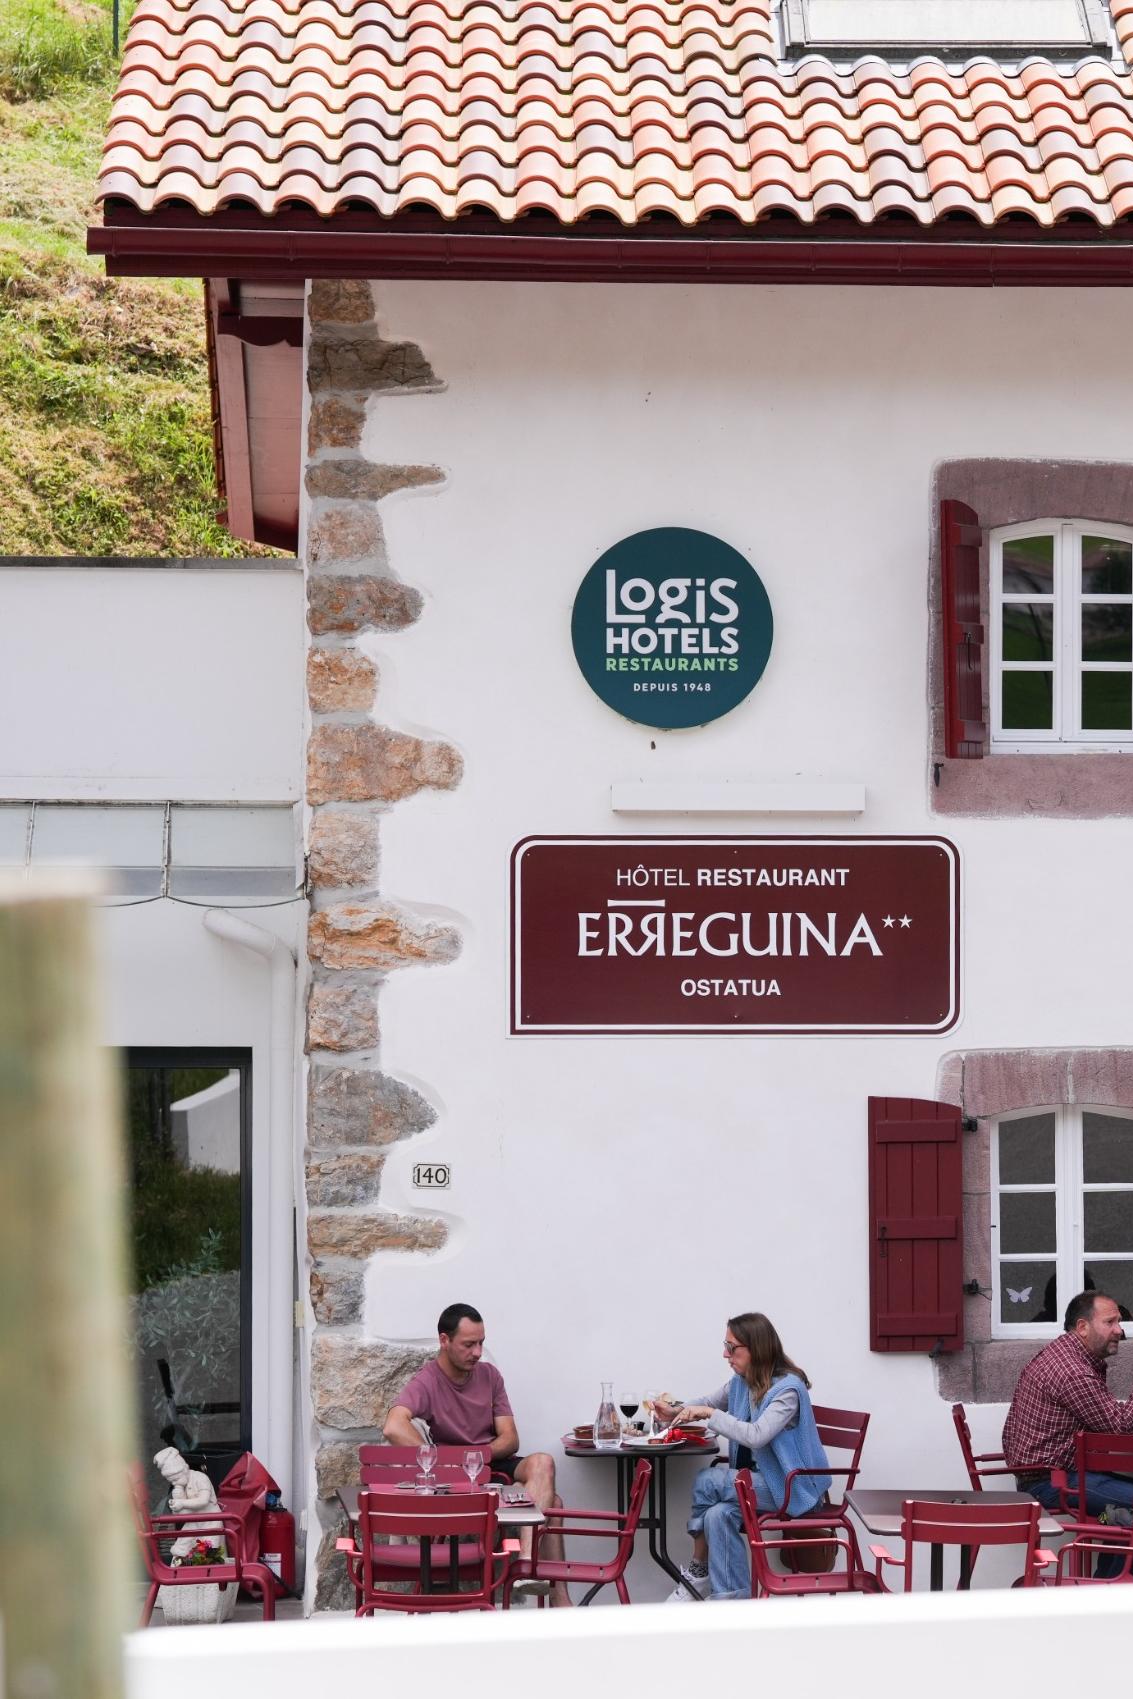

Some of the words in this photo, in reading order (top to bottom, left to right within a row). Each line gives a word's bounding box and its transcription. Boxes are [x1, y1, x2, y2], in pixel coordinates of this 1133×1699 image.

[605, 568, 740, 625] Logis
[605, 626, 740, 656] HOTELS
[605, 657, 740, 673] RESTAURANTS
[632, 682, 679, 693] DEPUIS
[682, 682, 712, 693] 1948
[616, 863, 691, 887] HÔTEL
[696, 867, 850, 887] RESTAURANT
[577, 899, 883, 957] ERREGUINA
[680, 978, 782, 997] OSTATUA
[416, 1166, 448, 1184] 140
